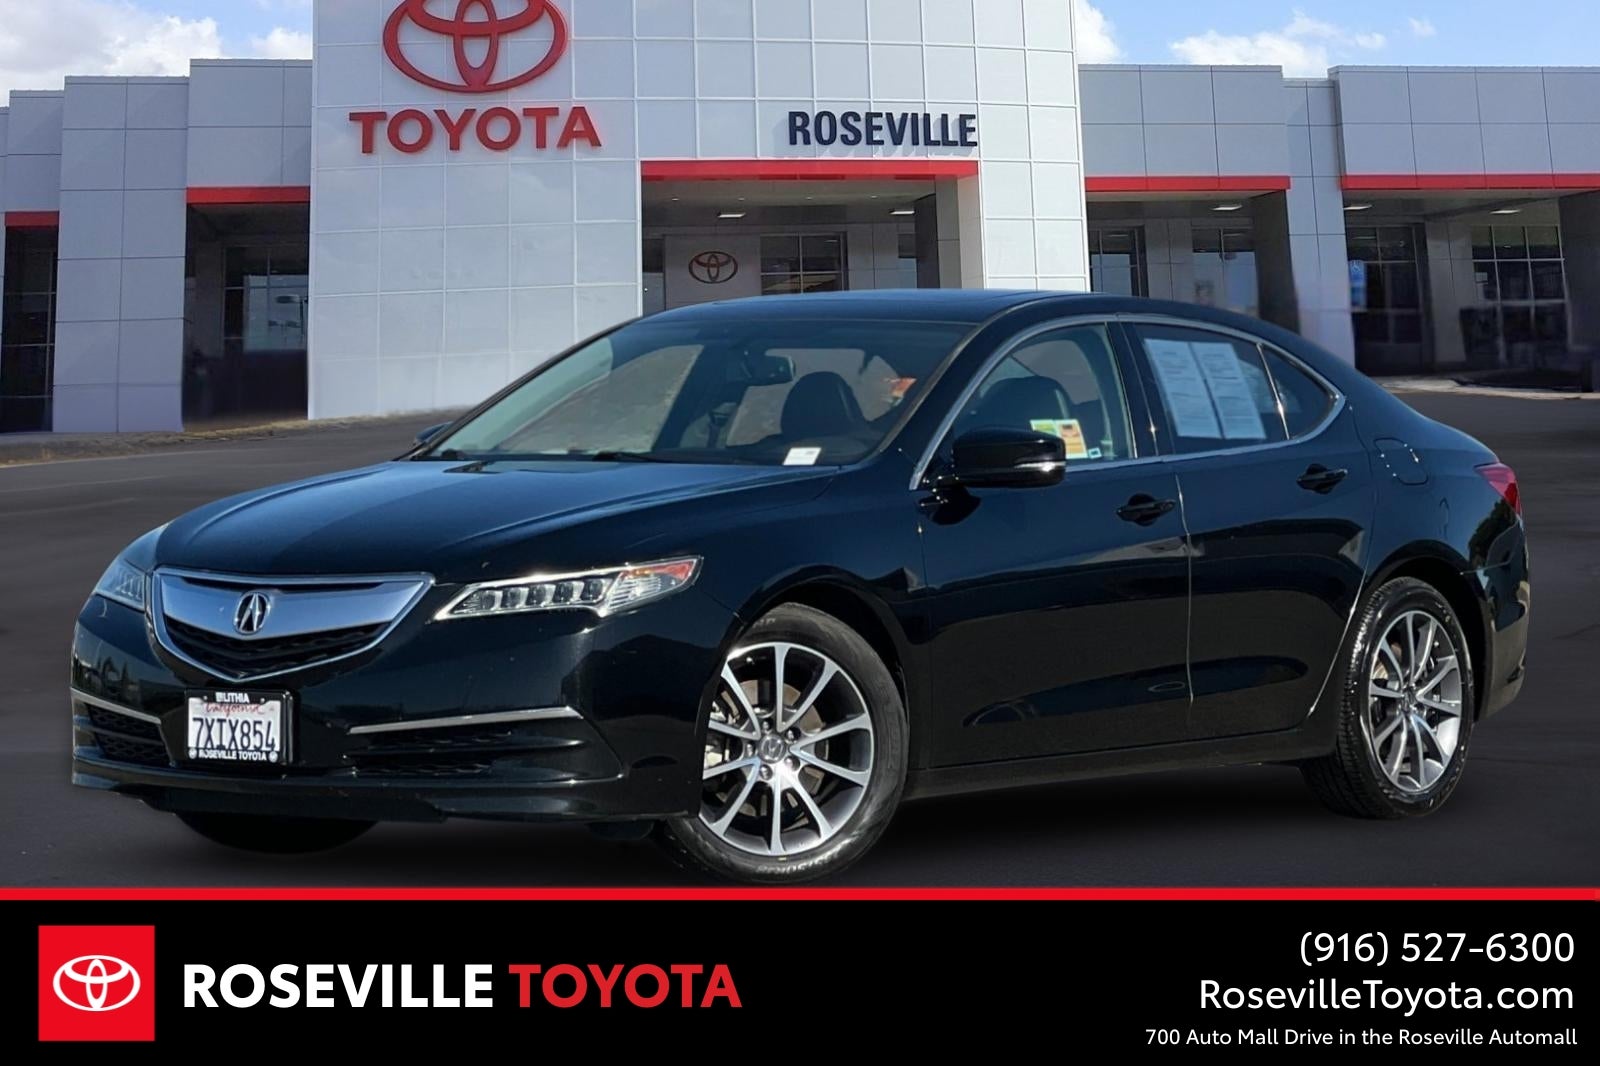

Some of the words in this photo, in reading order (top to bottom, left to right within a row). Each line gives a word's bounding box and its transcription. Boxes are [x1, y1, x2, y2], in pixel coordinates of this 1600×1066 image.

[349, 106, 602, 154] TOYOTA
[788, 110, 978, 147] ROSEVILLE
[192, 717, 276, 752] 7XIX854
[198, 749, 237, 760] ROSEVILLE
[238, 751, 267, 761] TOYOTA
